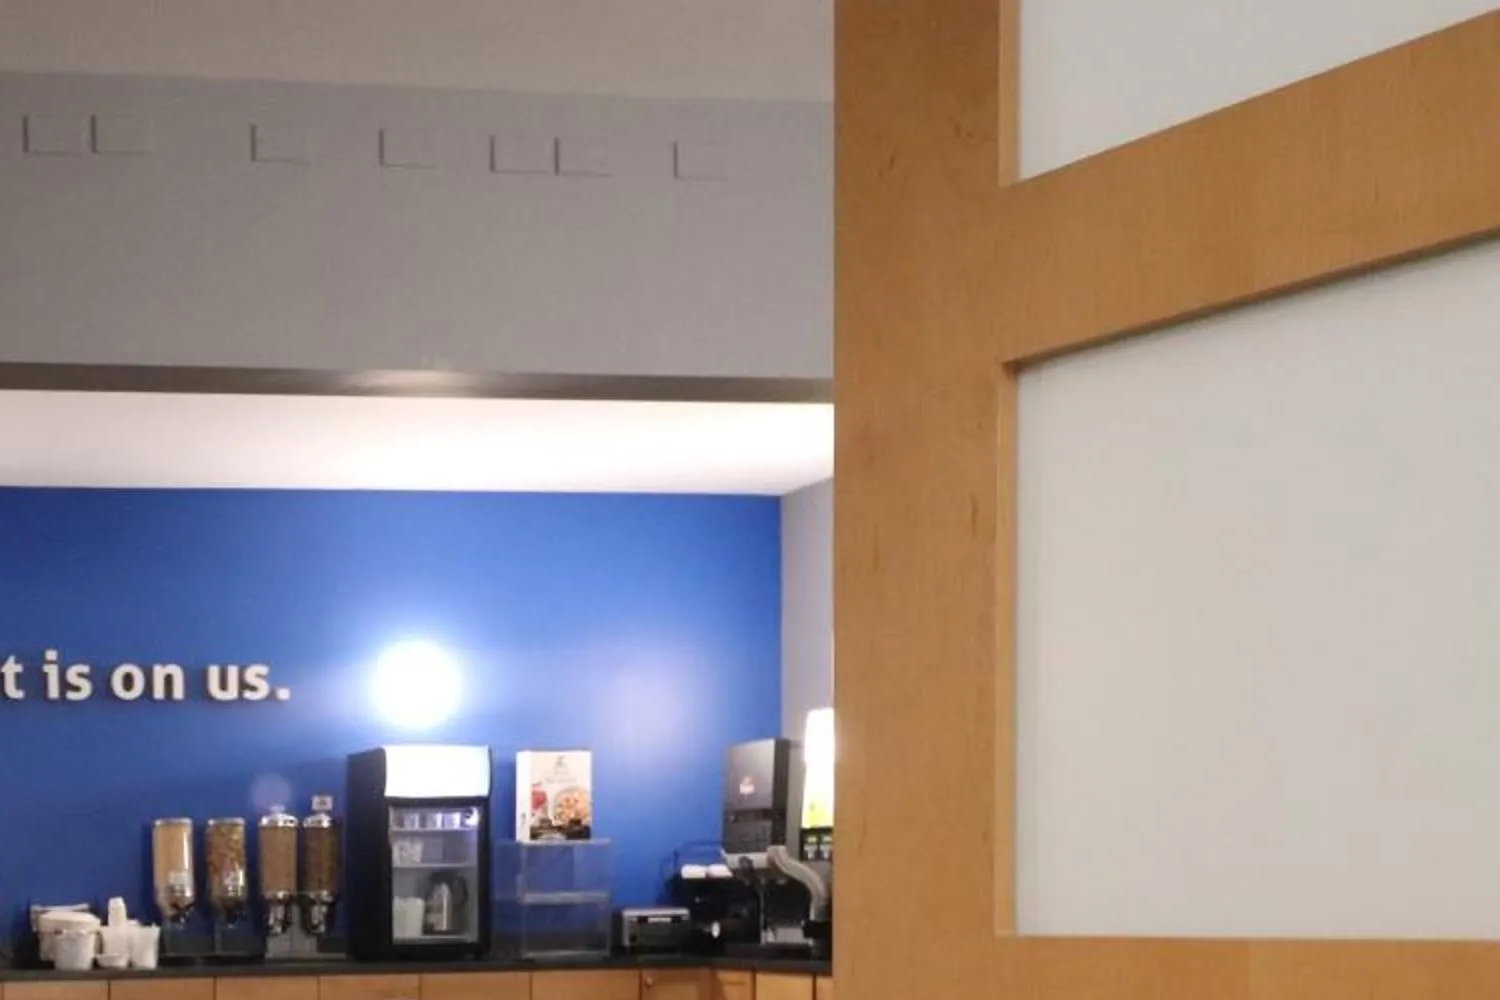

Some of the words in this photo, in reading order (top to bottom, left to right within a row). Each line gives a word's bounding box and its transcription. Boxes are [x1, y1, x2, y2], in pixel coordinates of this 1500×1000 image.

[42, 650, 92, 700] is
[111, 663, 184, 700] on
[207, 664, 292, 701] us.
